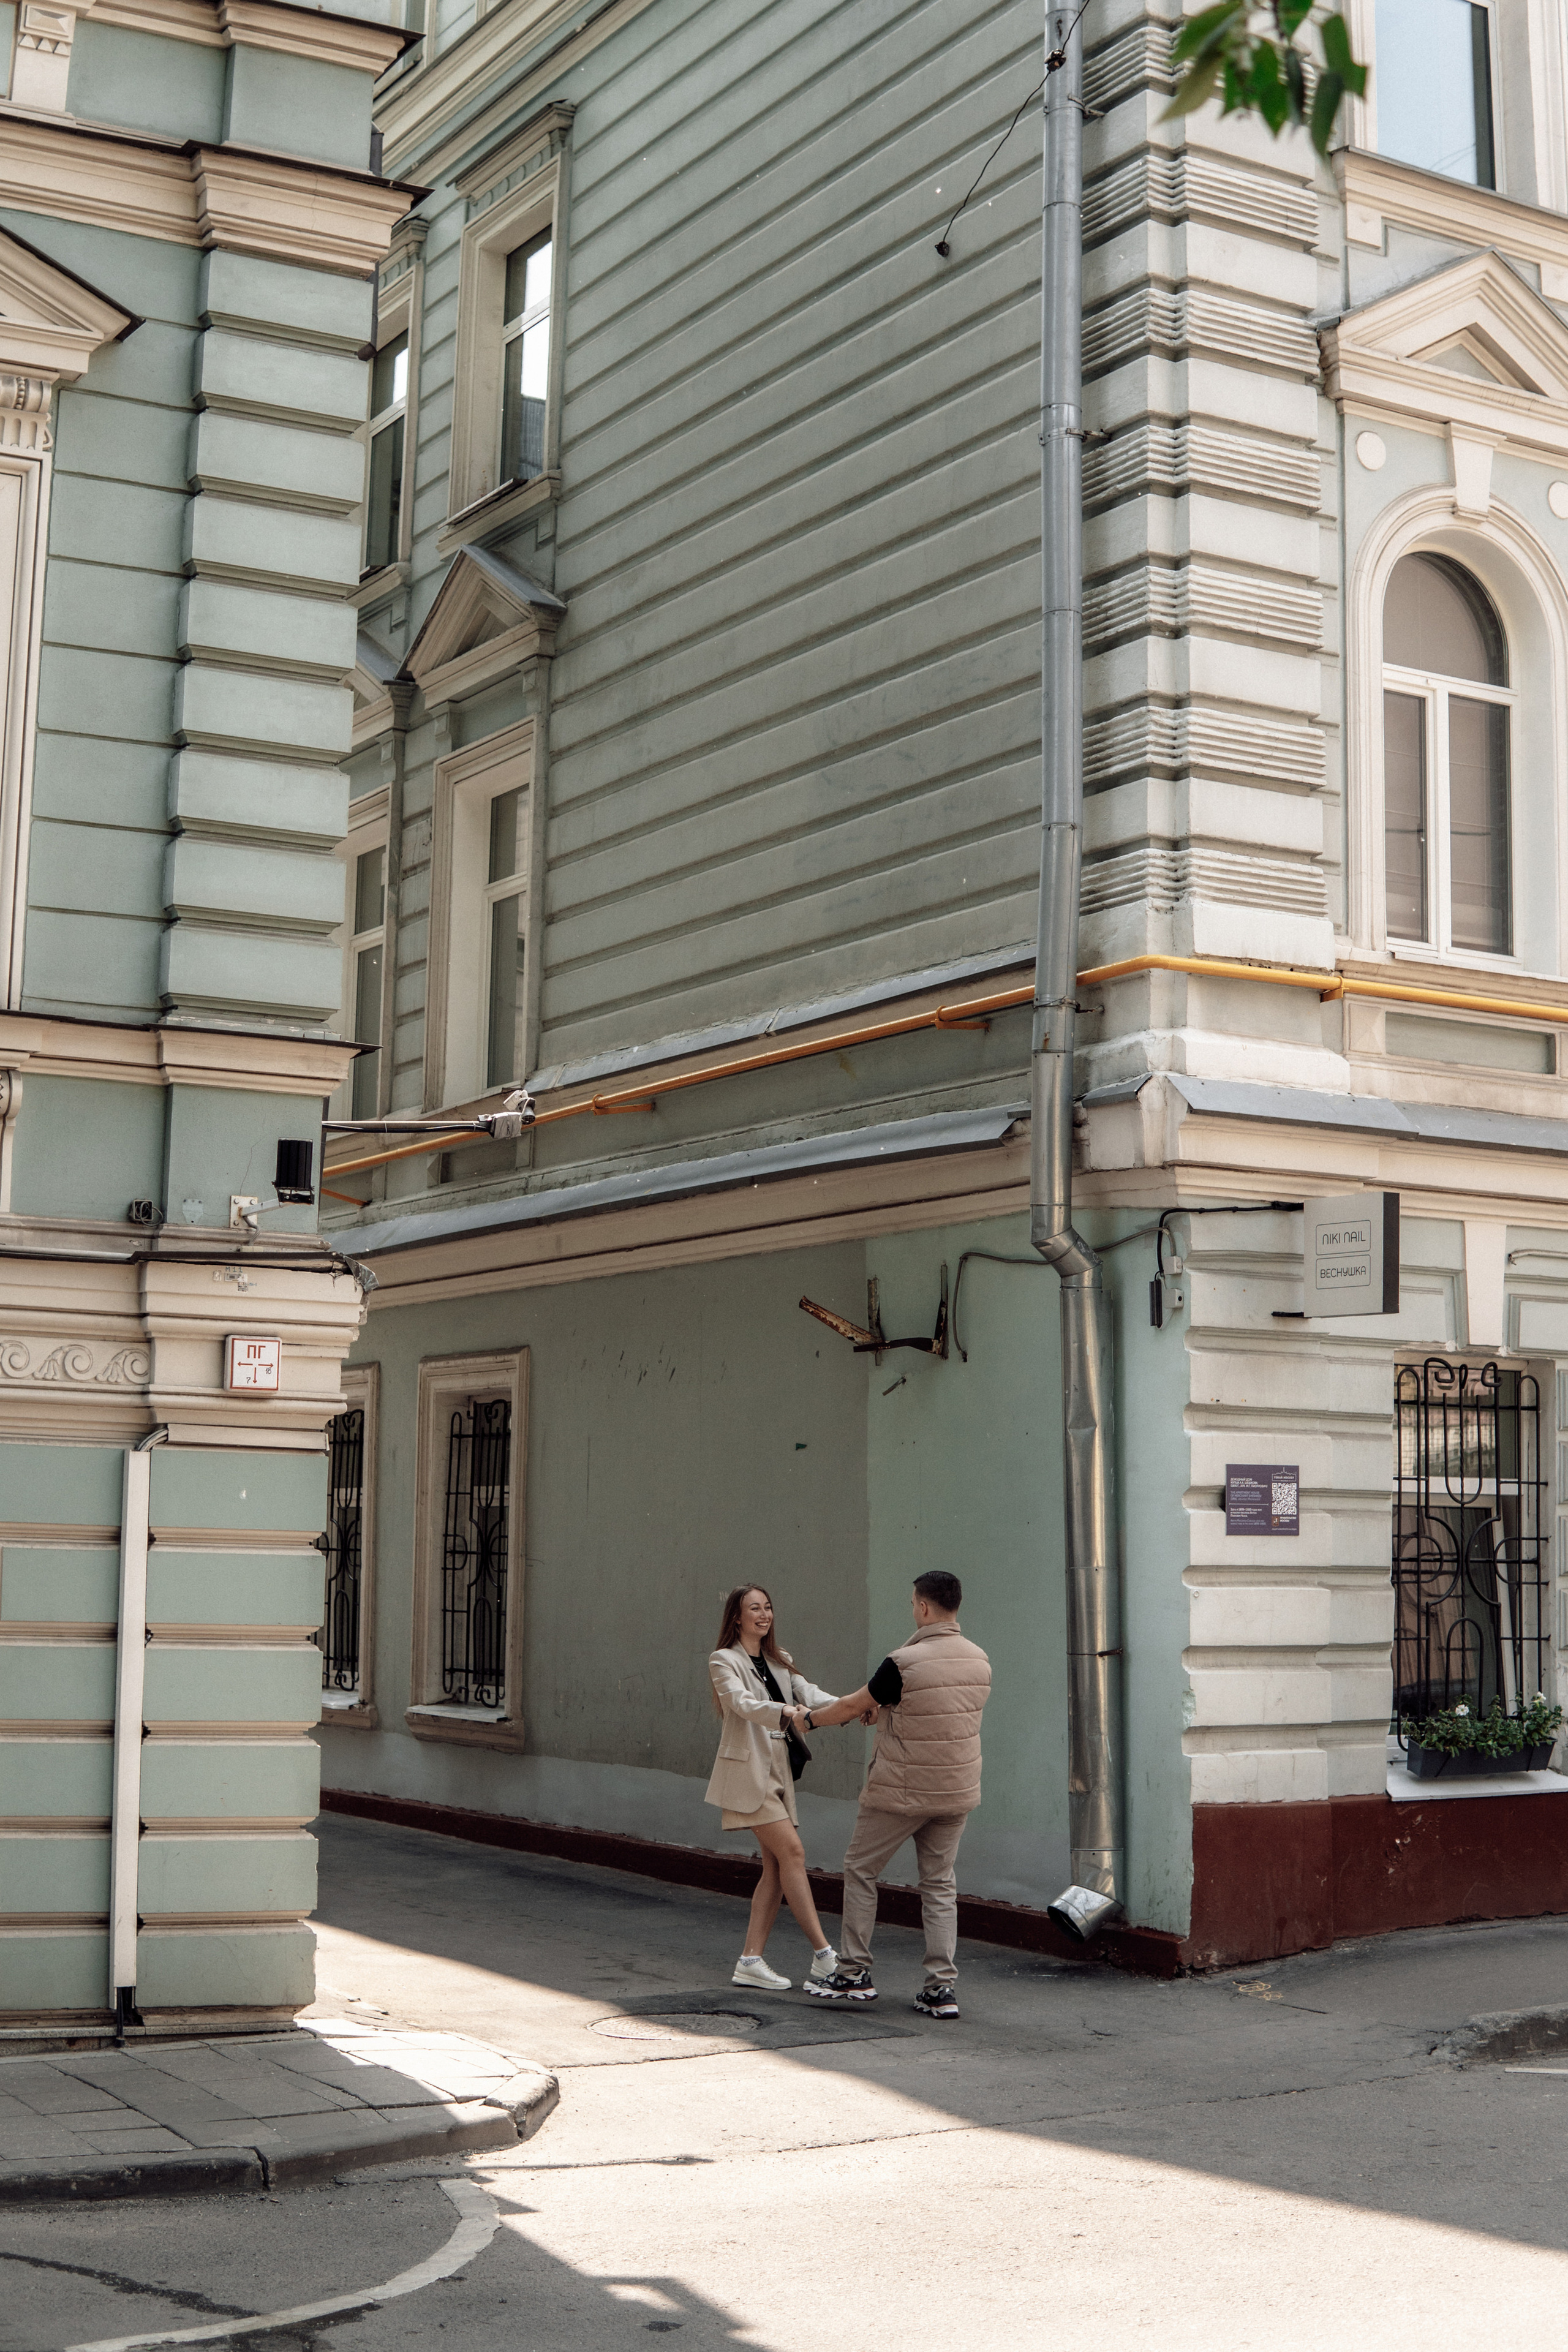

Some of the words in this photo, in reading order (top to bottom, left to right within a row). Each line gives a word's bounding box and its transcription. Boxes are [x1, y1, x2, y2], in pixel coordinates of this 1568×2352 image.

[1322, 1232, 1341, 1245] NIKI
[1343, 1231, 1366, 1243] NAIL
[1320, 1265, 1366, 1278] ВЕСНУШКА
[247, 1344, 266, 1359] ПГ
